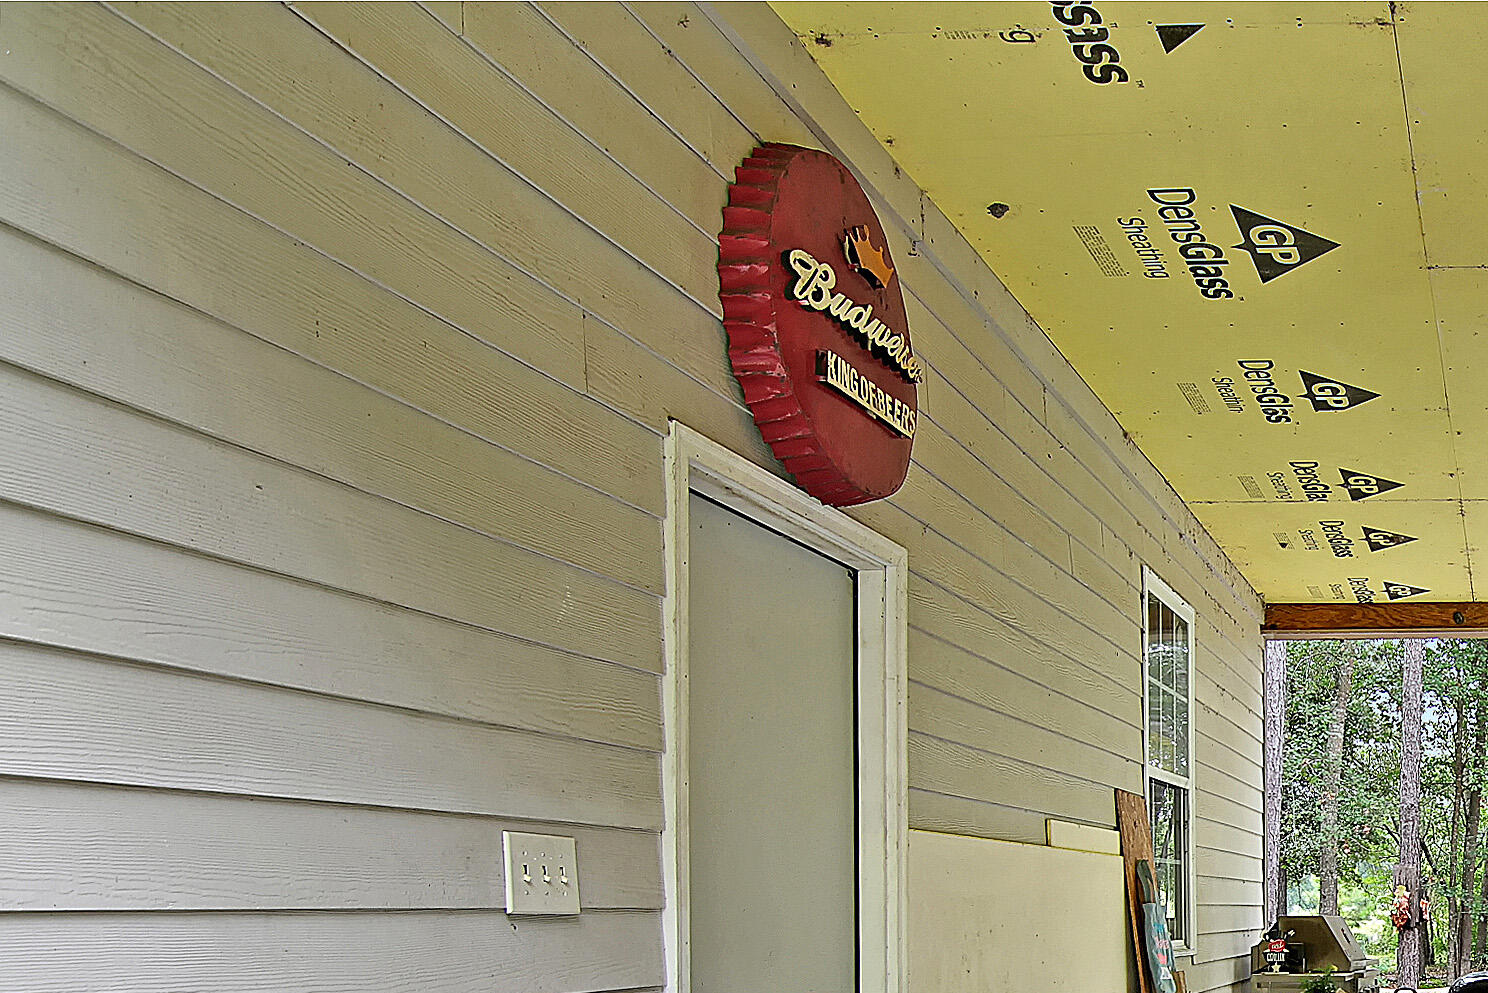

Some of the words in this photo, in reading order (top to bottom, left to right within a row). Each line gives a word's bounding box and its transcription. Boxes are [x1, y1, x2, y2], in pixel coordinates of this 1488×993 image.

[1117, 216, 1171, 280] Sheathing
[1146, 187, 1234, 301] DensGlass
[1248, 224, 1301, 266] GP
[827, 350, 860, 393] KING
[860, 374, 878, 408] OF
[877, 388, 917, 437] BEERS
[1310, 381, 1350, 410] GP
[1347, 475, 1379, 496] GP
[1369, 530, 1395, 548] GP
